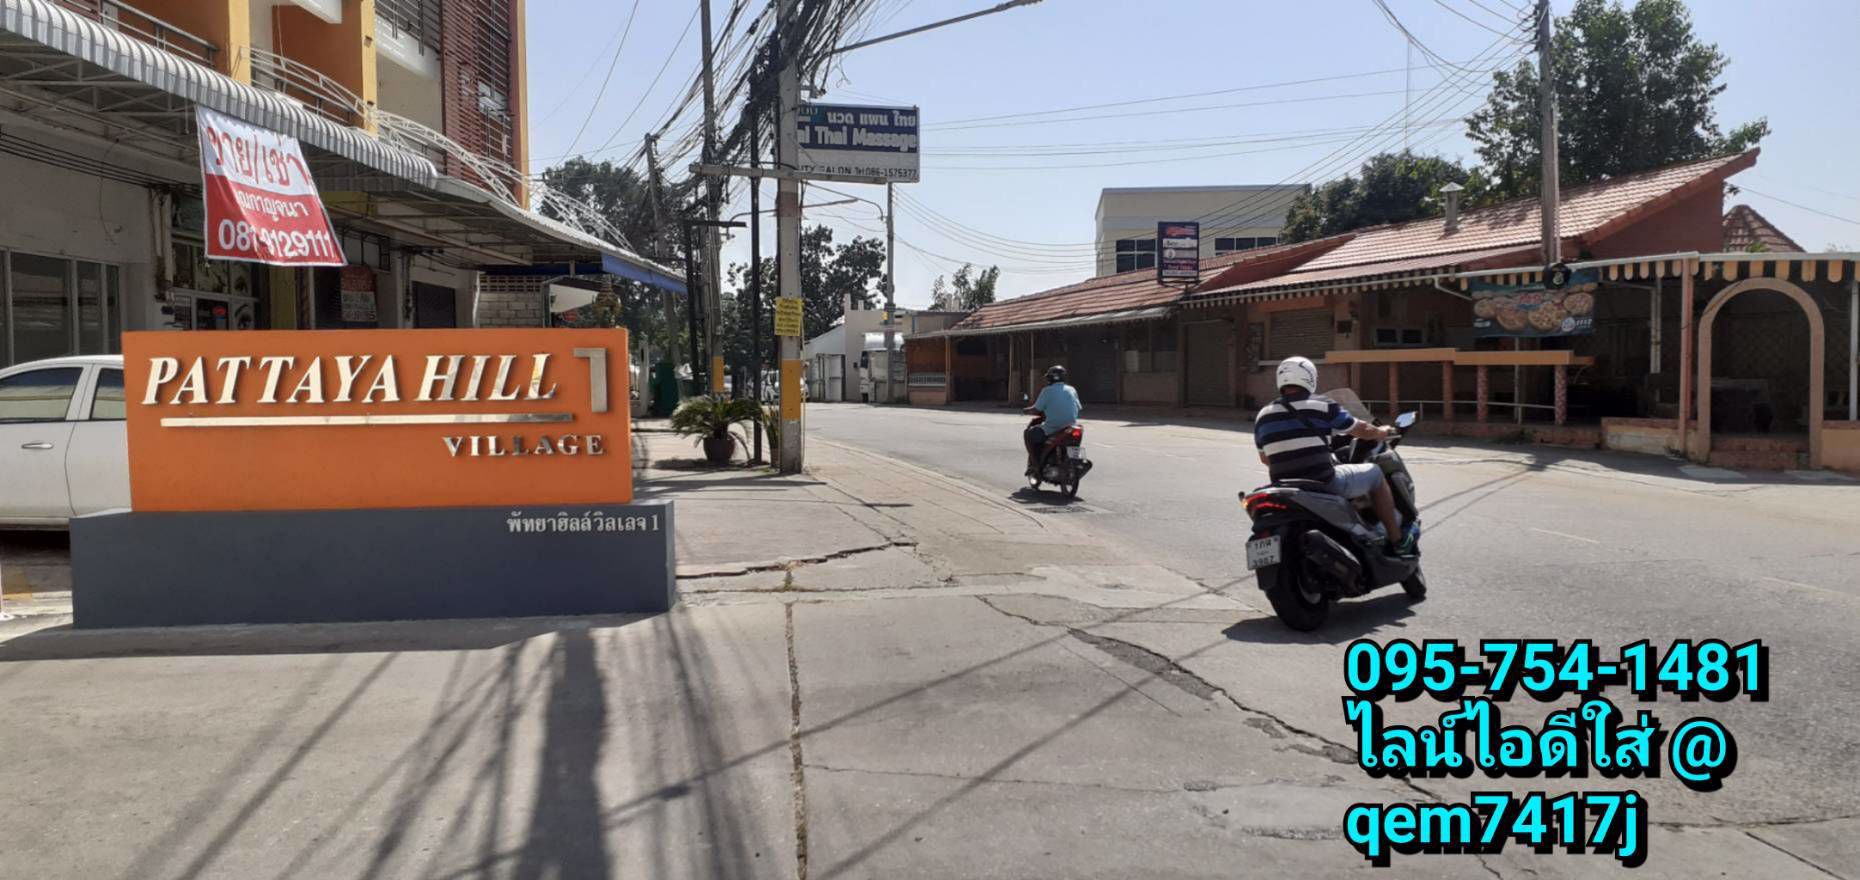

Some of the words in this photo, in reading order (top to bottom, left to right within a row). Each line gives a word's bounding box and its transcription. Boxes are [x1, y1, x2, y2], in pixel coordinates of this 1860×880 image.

[892, 110, 916, 128] ไทย
[797, 125, 810, 144] al
[814, 125, 848, 146] Thai
[852, 127, 917, 153] Massage
[142, 354, 401, 405] PATTAYA
[414, 353, 558, 402] HILL
[573, 347, 608, 413] 1
[442, 434, 605, 458] VILLAGE
[651, 514, 659, 531] 1
